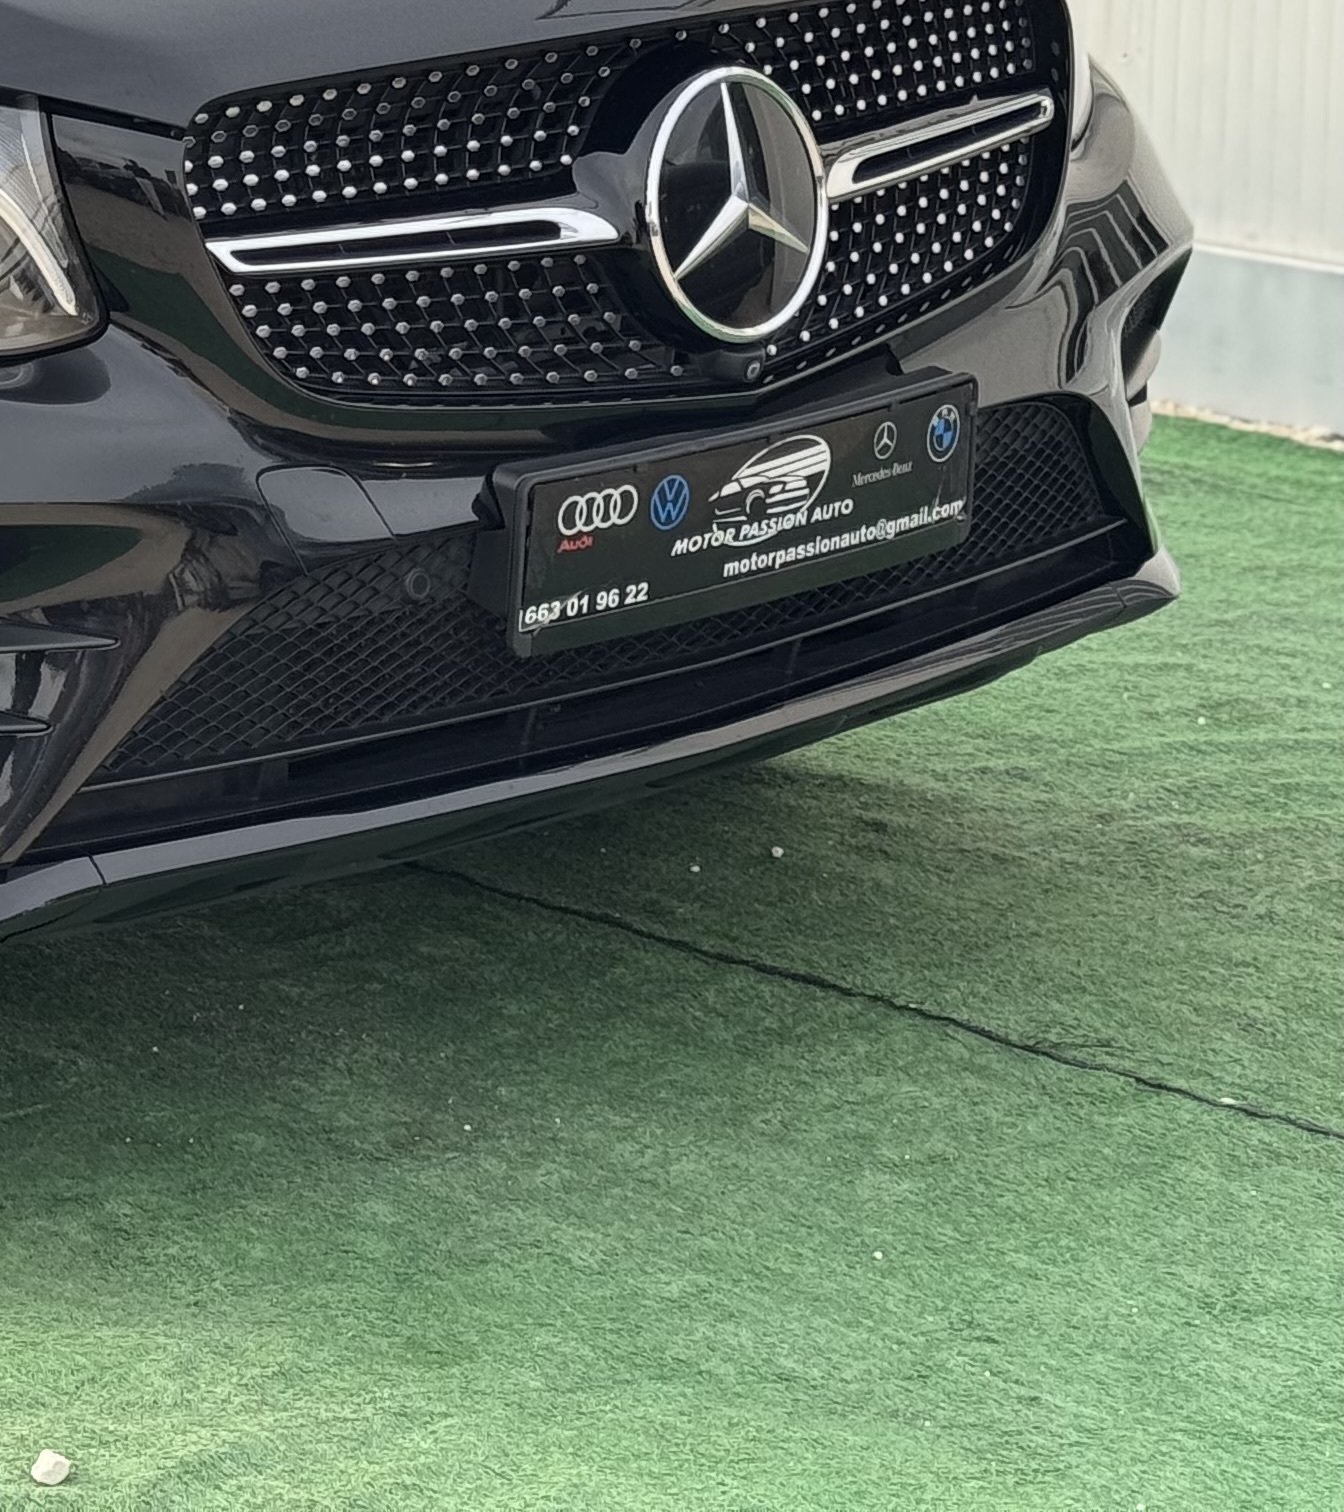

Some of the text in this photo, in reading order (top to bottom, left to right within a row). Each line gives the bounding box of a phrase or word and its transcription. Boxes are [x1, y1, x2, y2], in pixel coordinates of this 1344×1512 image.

[669, 498, 855, 557] MOTOR PASSION AUTO
[723, 499, 965, 578] motorpassionauto@gmail.com
[524, 581, 650, 625] 663 01 96 22
